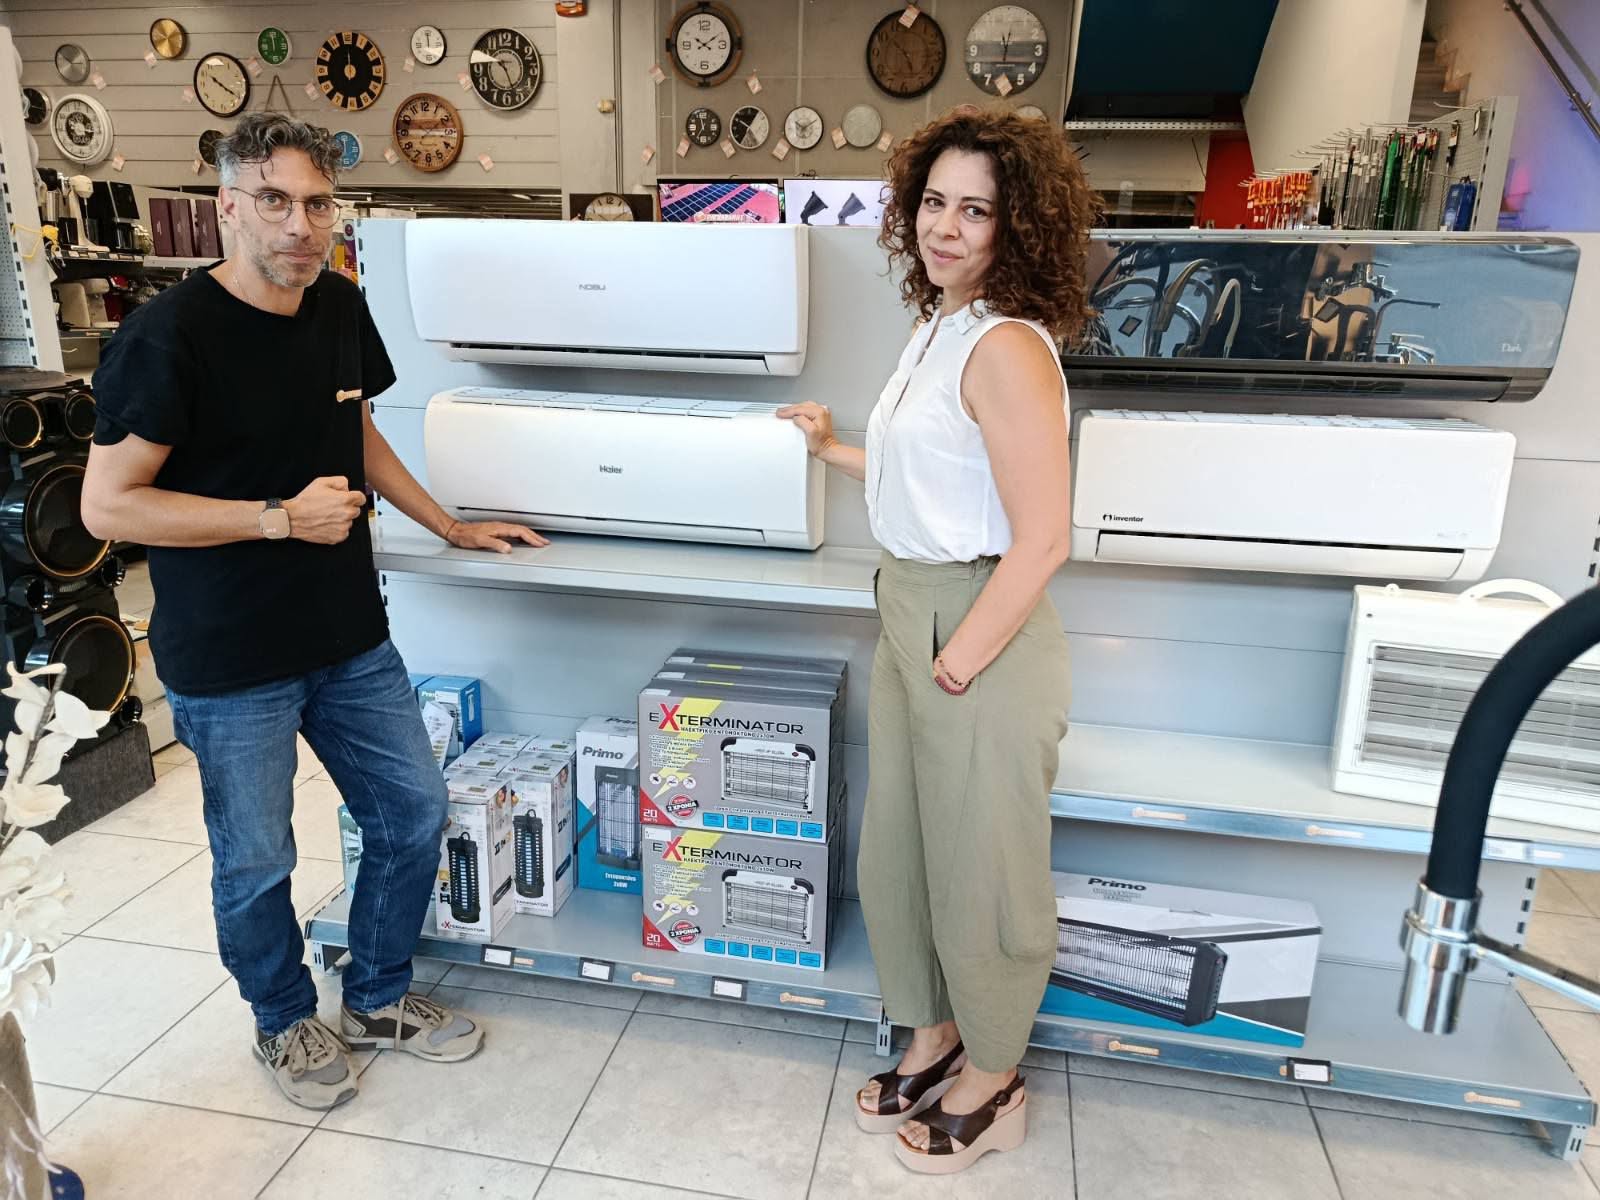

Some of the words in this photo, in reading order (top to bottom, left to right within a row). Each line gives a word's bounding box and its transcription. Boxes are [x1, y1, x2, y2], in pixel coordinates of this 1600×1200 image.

[699, 20, 711, 31] 12
[499, 32, 512, 47] 12
[1031, 28, 1039, 40] 2
[515, 35, 520, 49] 1
[682, 41, 691, 51] 9
[718, 40, 727, 50] 3
[524, 46, 533, 60] 2
[969, 45, 978, 57] 9
[1034, 44, 1042, 57] 3
[473, 63, 483, 78] 9
[529, 62, 538, 76] 3
[700, 60, 709, 70] 6
[973, 62, 981, 74] 8
[1028, 62, 1036, 74] 4
[479, 76, 488, 92] 8
[984, 73, 992, 86] 7
[1017, 73, 1025, 86] 5
[490, 88, 499, 104] 7
[502, 91, 512, 106] 6
[515, 89, 525, 103] 5
[420, 101, 430, 112] 12
[440, 114, 449, 126] 2
[400, 128, 409, 137] 9
[444, 128, 454, 136] 3
[404, 141, 413, 150] 8
[443, 141, 452, 150] 4
[413, 149, 422, 159] 7
[425, 152, 432, 163] 6
[435, 149, 444, 160] 5
[606, 196, 614, 205] 12
[600, 465, 622, 474] Haier
[649, 703, 803, 735] EXTERMINATOR
[582, 746, 624, 760] Primo
[673, 802, 697, 811] ΧΡΟΝΙΑ
[643, 808, 658, 818] 20
[652, 836, 802, 870] EXTERMINATOR
[1088, 878, 1147, 891] Primo
[675, 927, 699, 936] ΧΡΟΝΙΑ
[646, 933, 661, 943] 20
